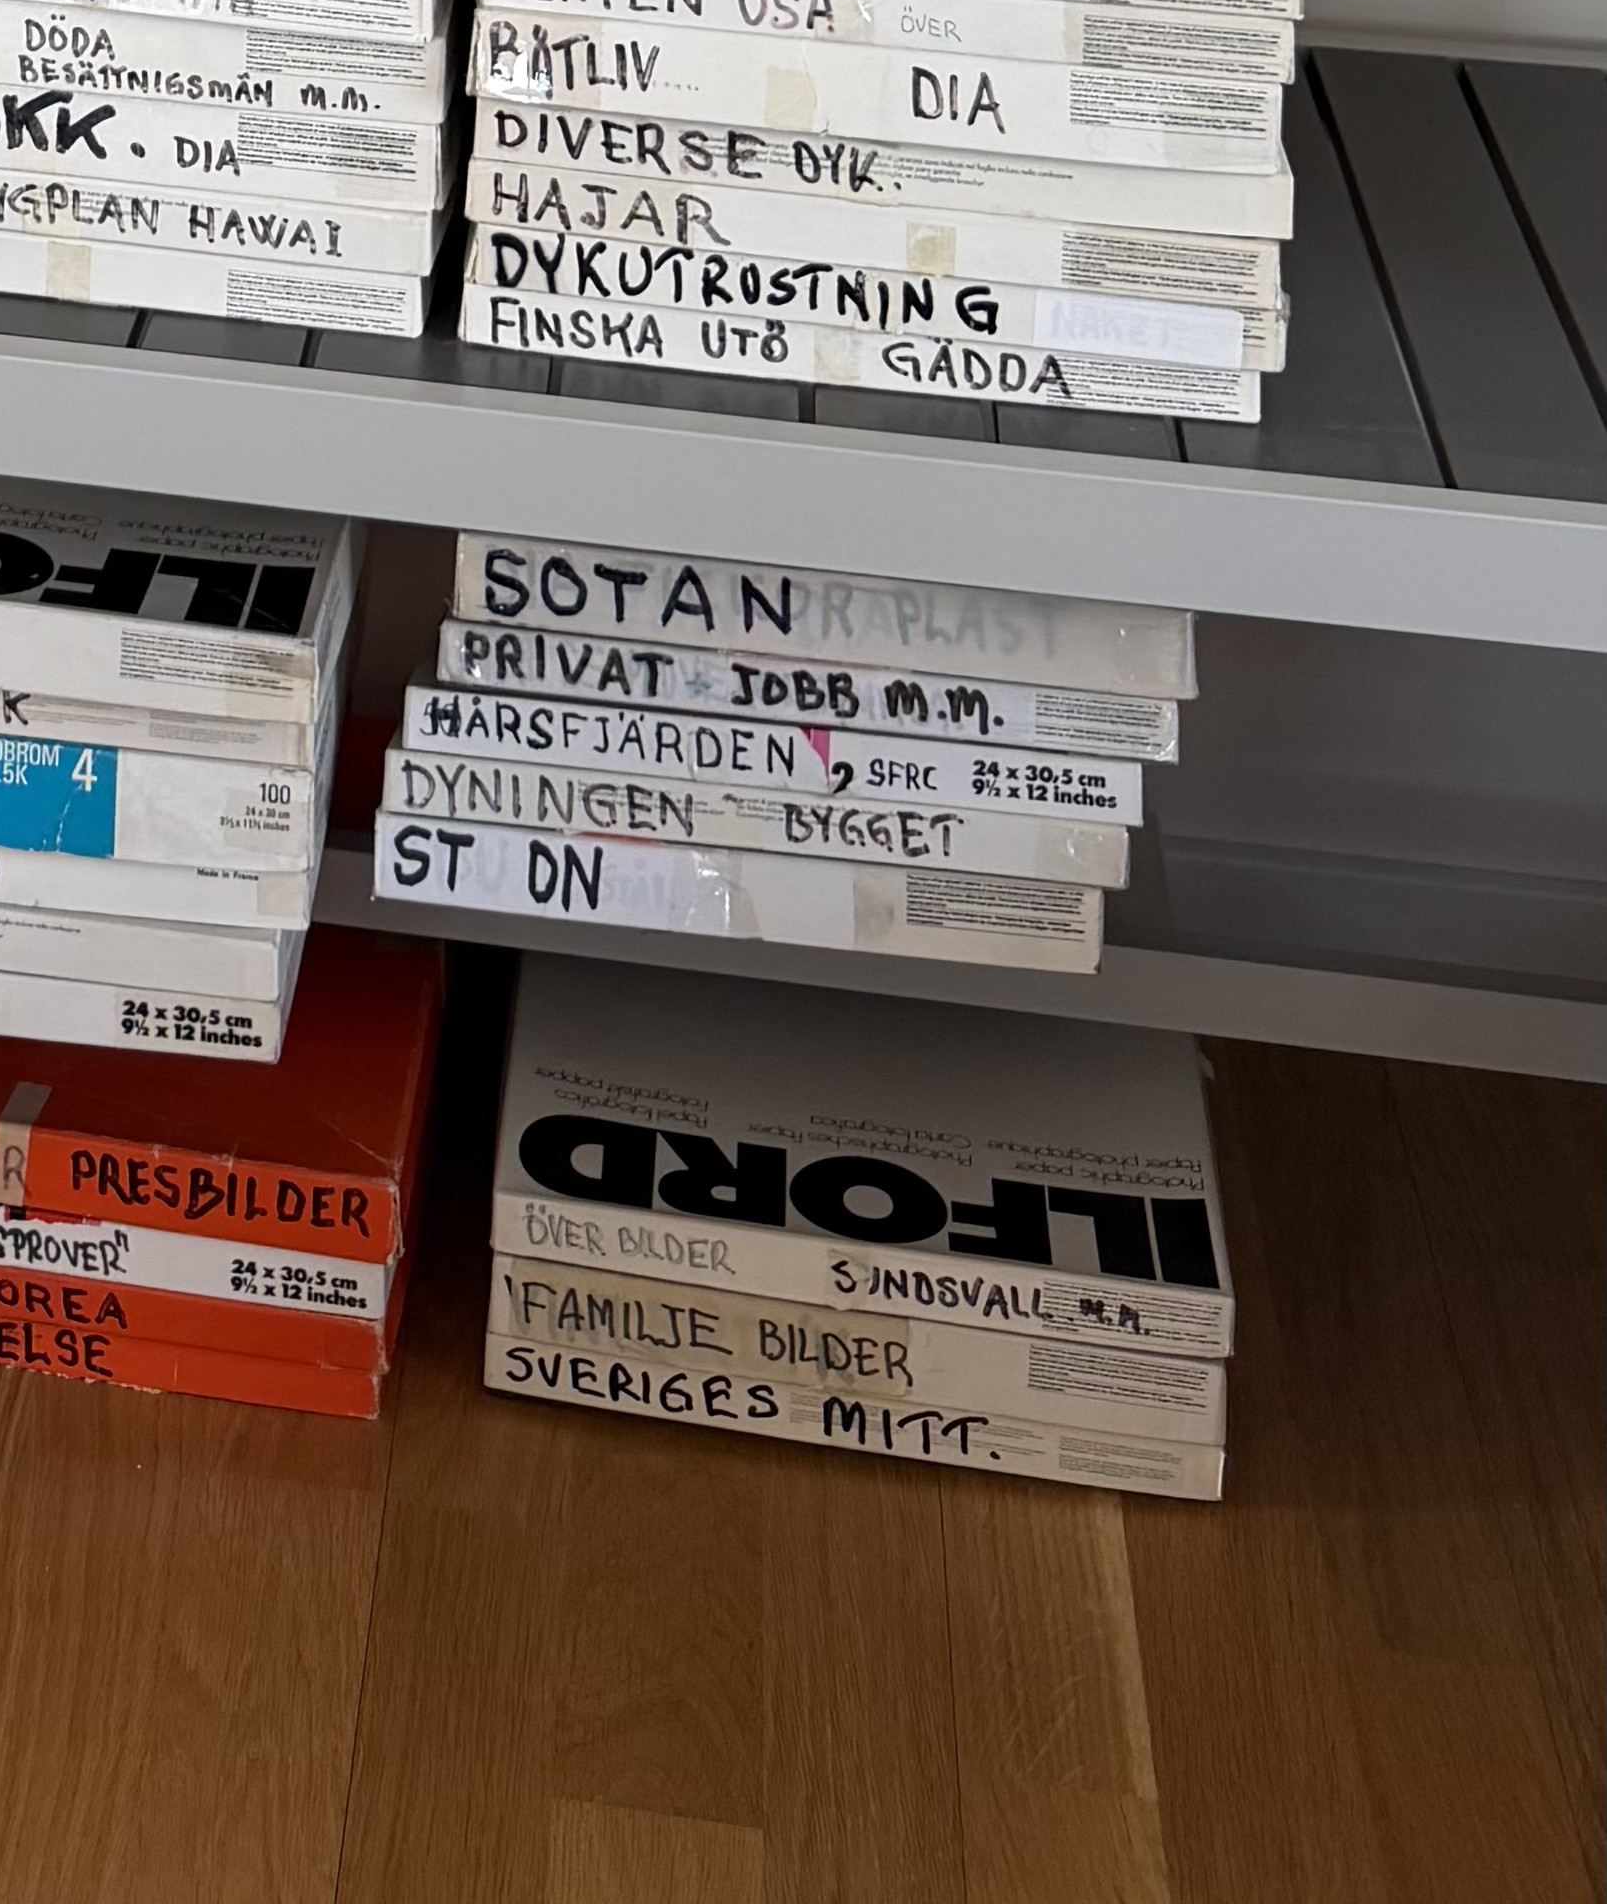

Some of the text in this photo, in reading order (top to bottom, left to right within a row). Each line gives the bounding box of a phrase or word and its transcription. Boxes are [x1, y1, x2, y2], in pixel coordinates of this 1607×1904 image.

[24, 12, 117, 61] DÖDA
[900, 5, 963, 43] ÖVER
[911, 65, 1007, 134] DIA
[172, 135, 241, 177] DIA
[493, 108, 766, 180] DIVERSE
[187, 203, 343, 257] HAWAI
[491, 172, 732, 246] HAJAR
[490, 295, 664, 359] FINSKA
[881, 336, 1071, 396] GÄDDA
[484, 548, 792, 636] SOTAN
[463, 629, 674, 697] PRIVAT
[70, 749, 99, 793] 4
[260, 783, 291, 805] 100
[400, 758, 694, 838] DYNINGEN
[70, 1148, 371, 1239] PRESBILDER
[518, 1113, 1222, 1290] ILFORD
[616, 1225, 737, 1275] BILDER
[520, 1277, 914, 1388] FAMILJE BILDER
[505, 1346, 781, 1421] SVERIGES
